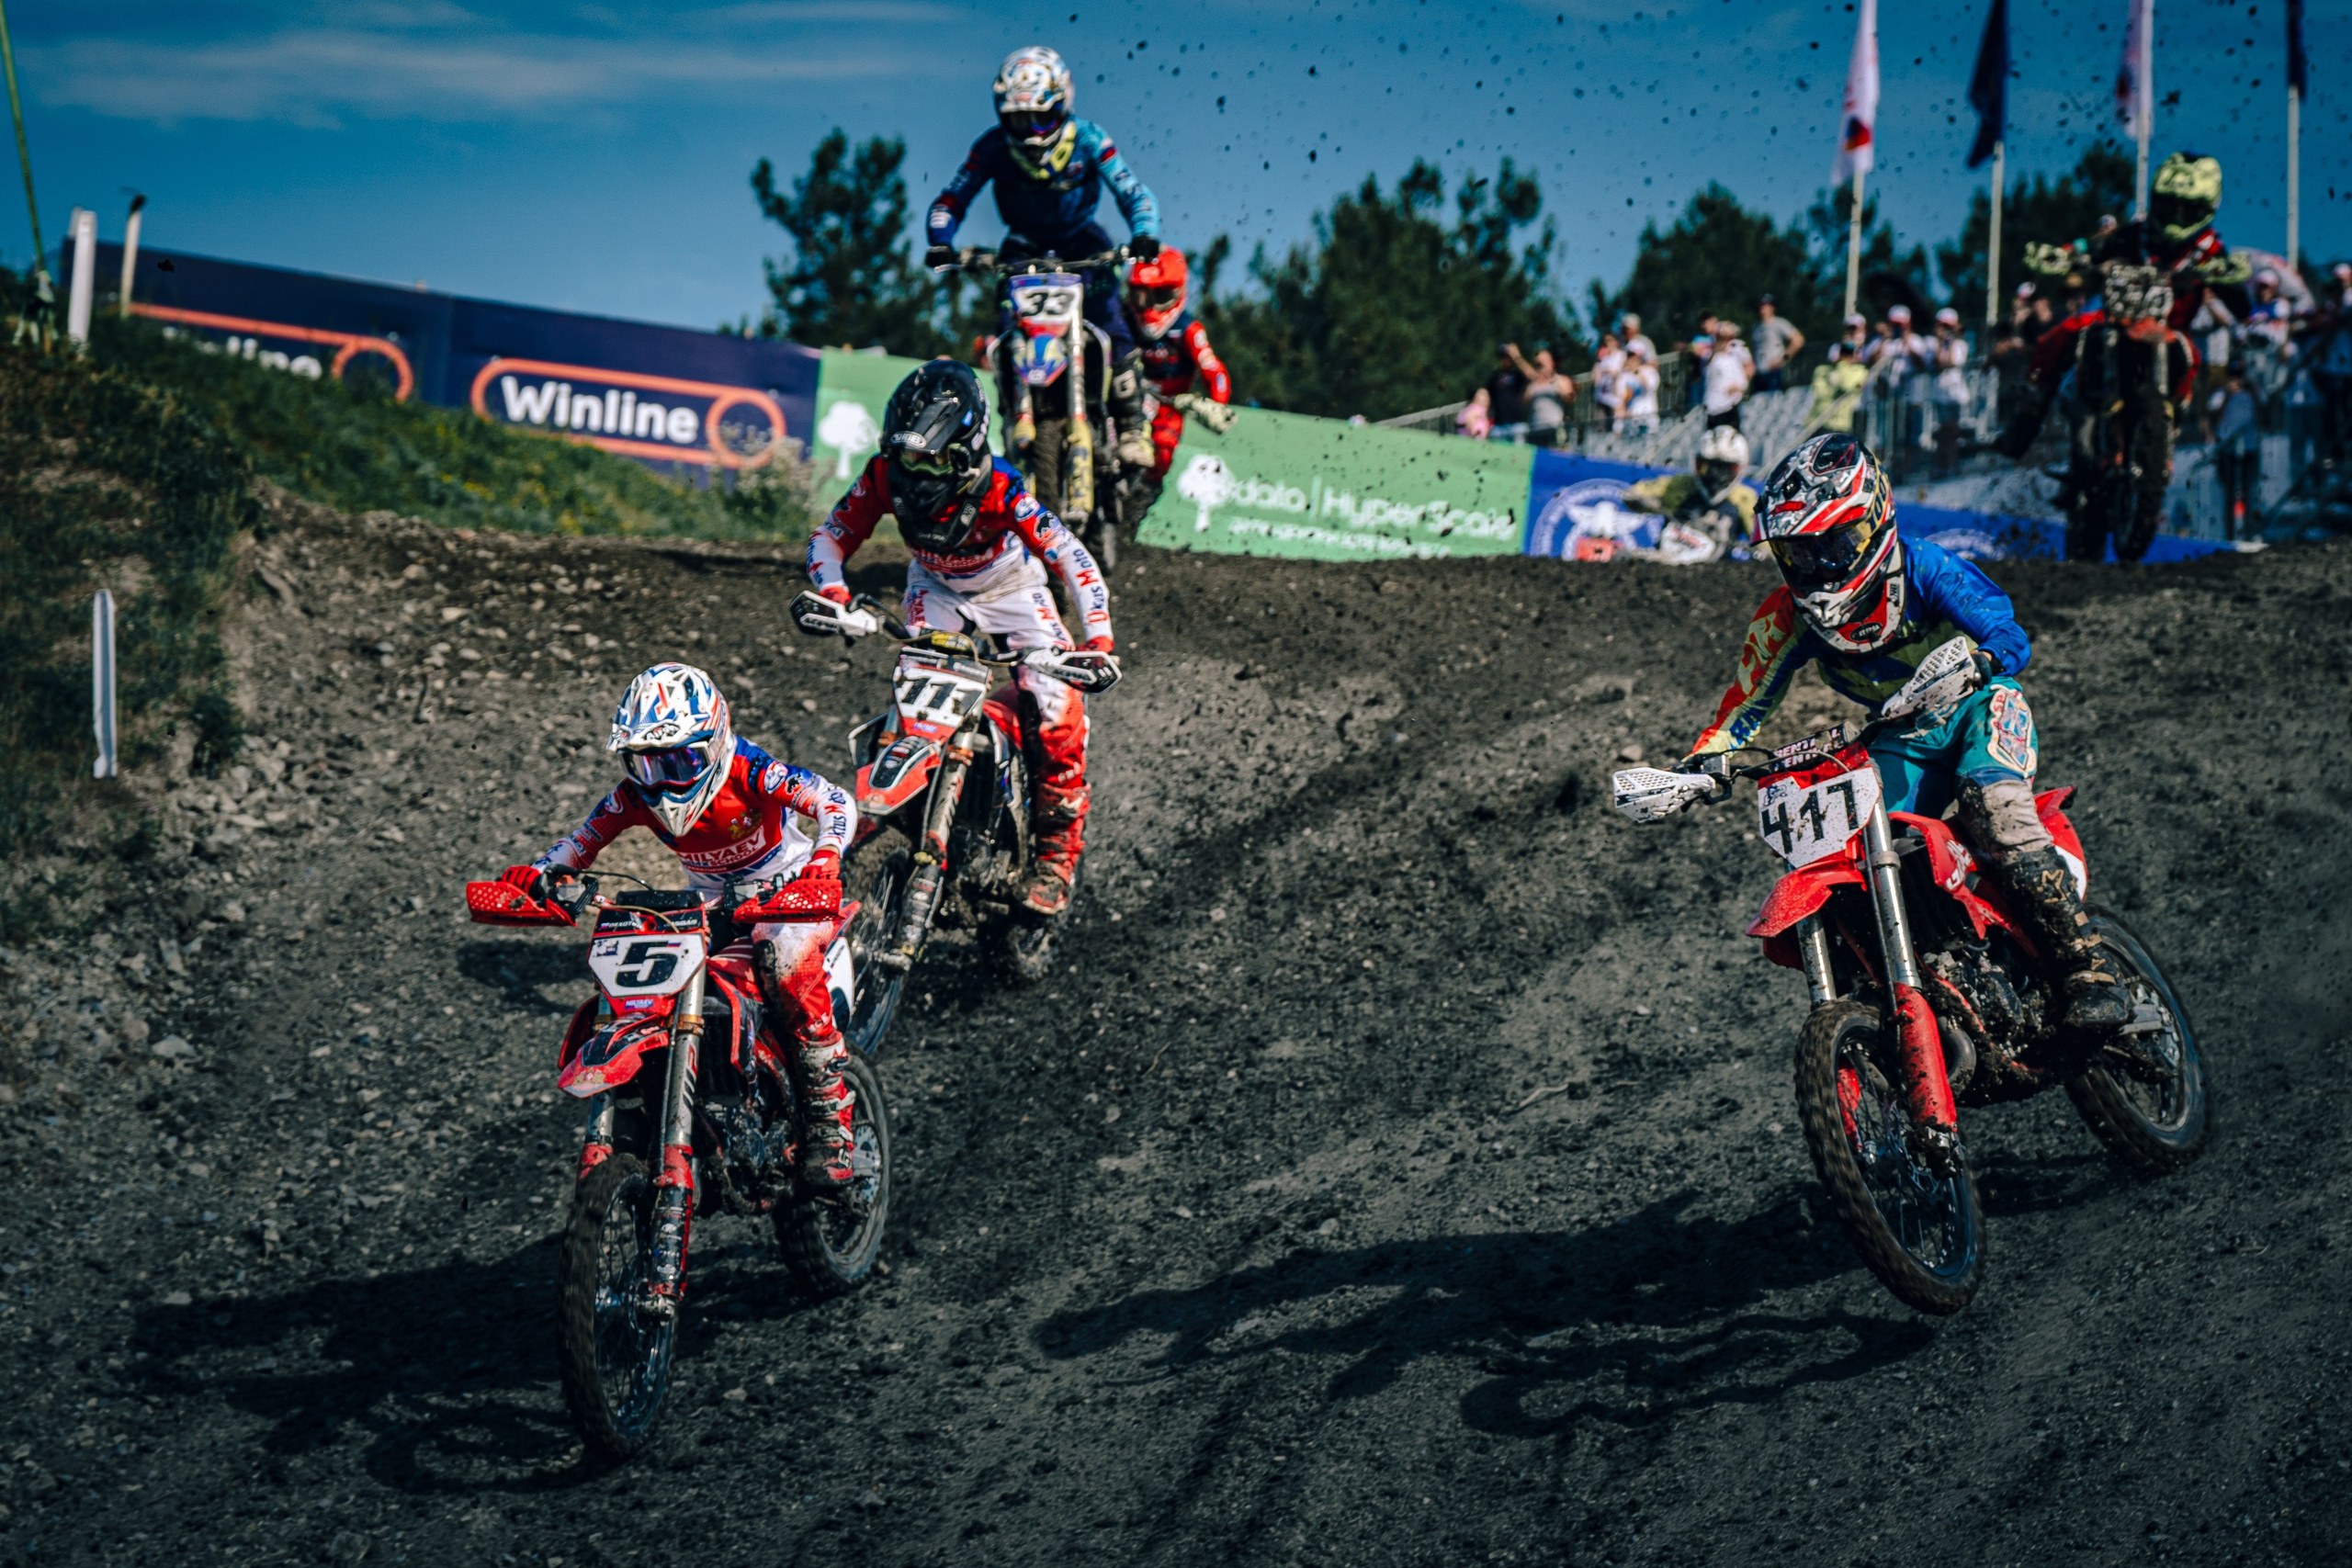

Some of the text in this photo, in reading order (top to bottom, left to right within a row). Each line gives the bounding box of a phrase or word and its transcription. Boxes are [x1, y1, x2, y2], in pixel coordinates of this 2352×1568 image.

[502, 376, 698, 444] Winline
[1774, 728, 1841, 759] RENTL
[1761, 779, 1859, 855] 417
[678, 829, 761, 863] MILYAEV
[615, 941, 679, 988] 5
